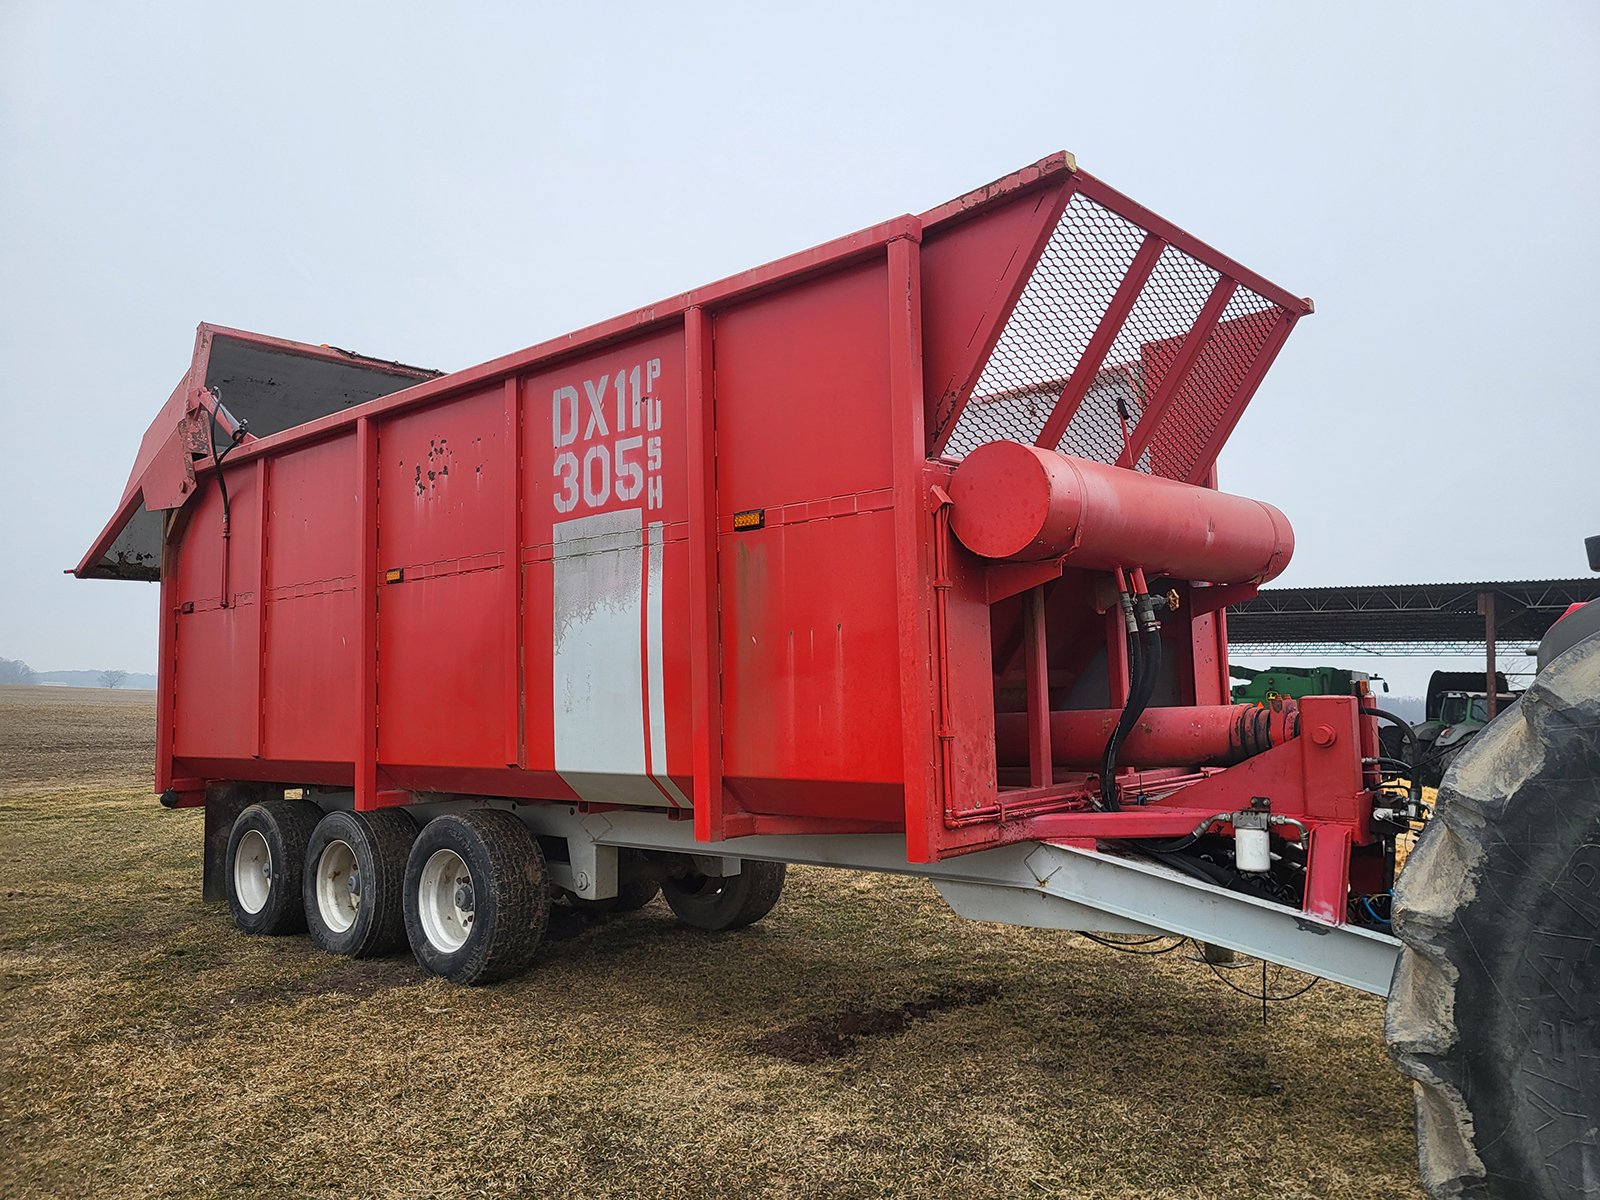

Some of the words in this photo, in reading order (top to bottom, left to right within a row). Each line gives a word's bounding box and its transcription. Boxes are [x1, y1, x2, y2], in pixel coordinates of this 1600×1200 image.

[552, 364, 641, 448] DX11
[646, 358, 663, 511] PUSH
[553, 435, 643, 513] 305
